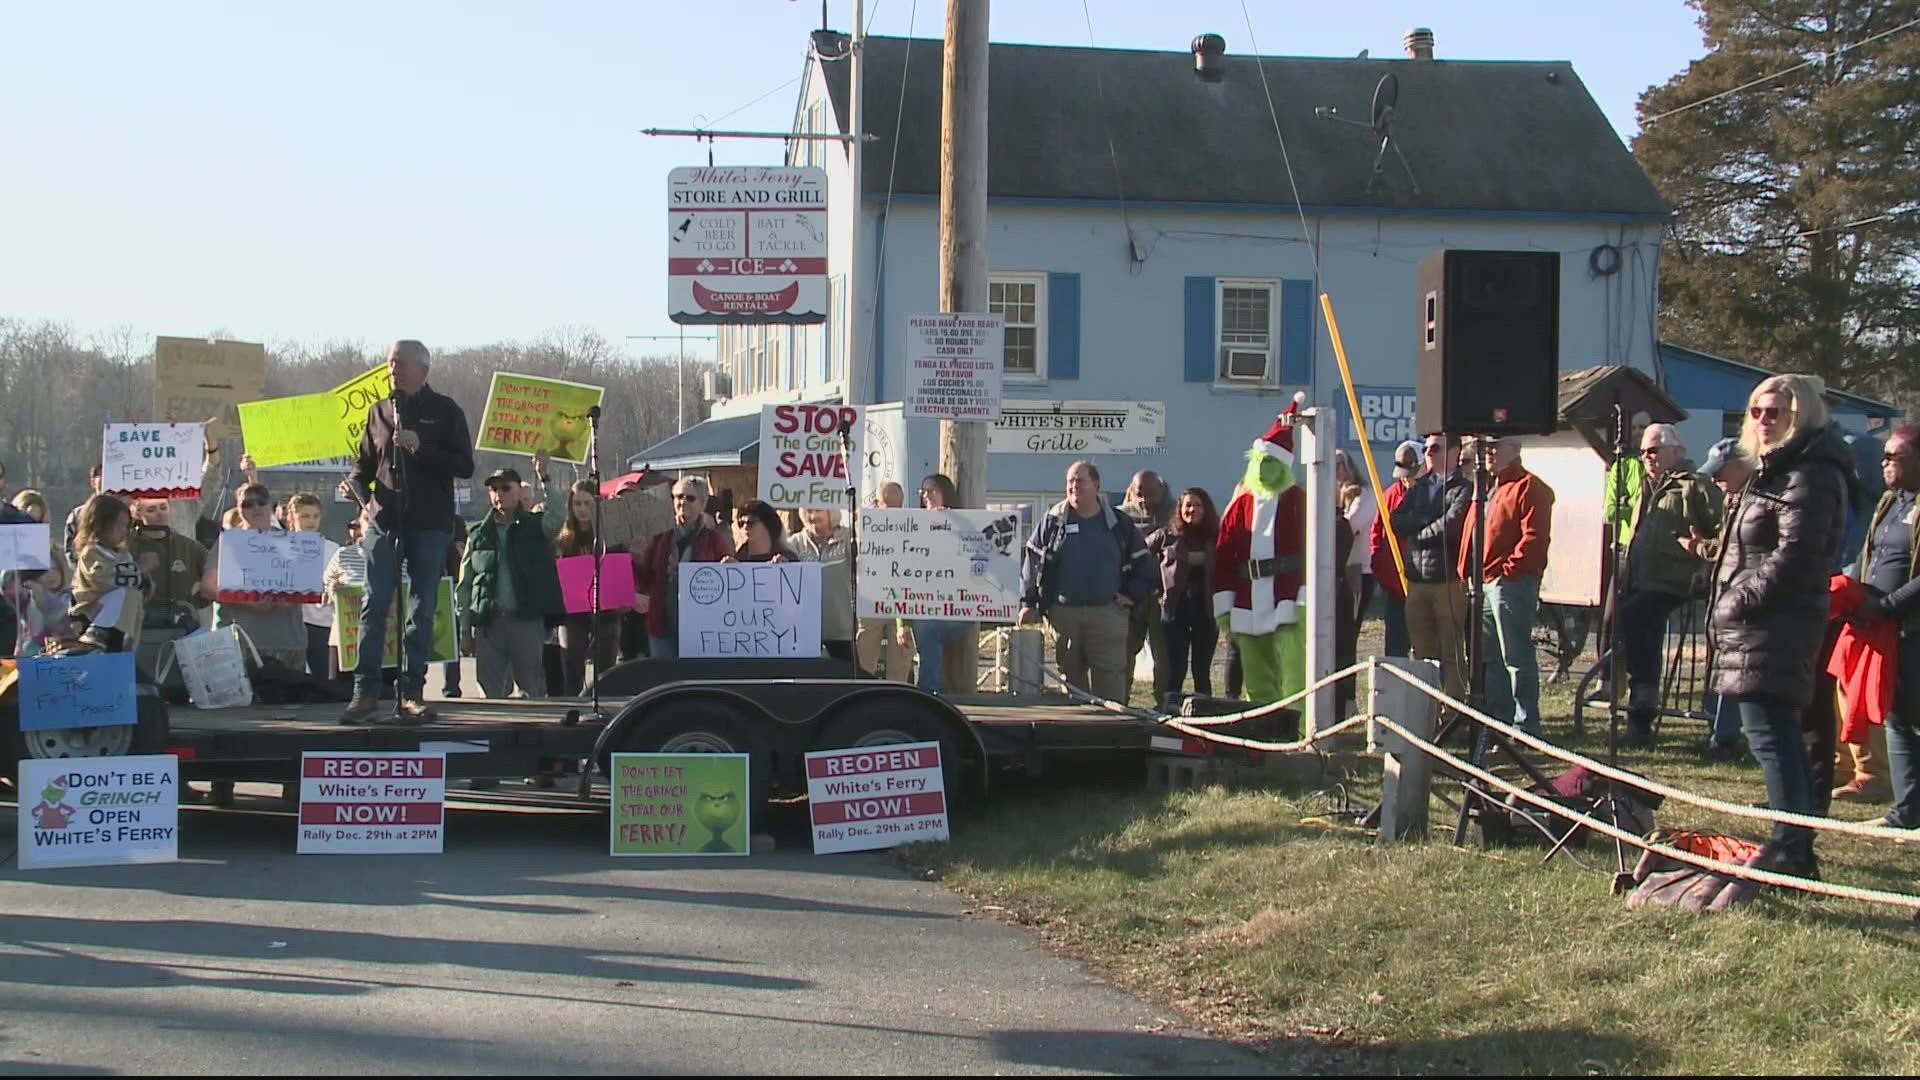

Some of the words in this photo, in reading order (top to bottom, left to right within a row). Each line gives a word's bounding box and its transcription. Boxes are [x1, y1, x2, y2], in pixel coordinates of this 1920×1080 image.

[673, 190, 726, 204] STORE
[731, 190, 770, 204] AND
[775, 190, 824, 204] GRILL
[699, 219, 736, 229] COLD
[758, 219, 785, 229] BAIT
[705, 230, 735, 240] BEER
[695, 241, 709, 251] TO
[716, 241, 736, 251] GO
[758, 241, 807, 251] TACKLE
[710, 293, 744, 301] CANOE
[754, 293, 780, 301] BOAT
[723, 301, 769, 310] RENTALS
[910, 319, 936, 327] PLEASE
[938, 320, 956, 328] HAVE
[977, 320, 999, 328] READY
[936, 347, 955, 355] CASH
[957, 347, 973, 355] ONLY
[939, 360, 947, 368] EL
[952, 370, 973, 378] FAVOR
[938, 379, 965, 387] COCHES
[927, 397, 945, 405] VIAJE
[948, 397, 956, 405] DE
[915, 406, 949, 414] EFECTIVO
[951, 406, 989, 415] SOLAMENTE
[522, 415, 542, 427] OUR
[774, 405, 857, 433] STOP
[994, 416, 1064, 428] WHITE'S
[1069, 416, 1126, 428] FERRY
[119, 430, 160, 442] SAVE
[487, 427, 541, 449] FERRY!
[773, 435, 800, 449] The
[806, 435, 856, 452] Grinh
[1027, 433, 1088, 452] Grille
[142, 446, 177, 458] OUR
[775, 451, 848, 478] SAVE
[769, 483, 805, 504] Our
[808, 481, 851, 504] Ferr
[862, 515, 920, 533] Poolesville
[247, 535, 279, 553] Save
[902, 540, 930, 557] Ferry
[866, 567, 877, 577] to
[891, 560, 955, 583] Reopen
[689, 565, 802, 605] OPEN
[901, 588, 934, 601] Town
[937, 590, 946, 601] is
[947, 593, 954, 602] a
[957, 589, 993, 603] Town,
[874, 601, 894, 615] No
[894, 601, 942, 617] Matter
[943, 602, 973, 617] How
[723, 608, 776, 629] OUR
[700, 625, 797, 655] FERRY!
[323, 759, 423, 777] REOPEN
[826, 751, 921, 775] REOPEN
[68, 771, 127, 788] DON'T
[132, 773, 155, 785] BE
[160, 772, 172, 785] A
[622, 766, 658, 779] DON'T
[319, 784, 379, 797] White's
[384, 785, 427, 800] Ferry
[621, 785, 642, 800] THE
[645, 785, 688, 799] GRINCH
[824, 780, 881, 796] White's
[886, 777, 926, 791] Ferry
[79, 791, 161, 806] GRINCH
[89, 809, 140, 824] OPEN
[335, 805, 408, 822] NOW!
[621, 804, 655, 817] STEAL
[660, 804, 684, 817] OUR
[844, 798, 911, 820] NOW!
[34, 828, 112, 847] WHITE'S
[118, 827, 174, 842] FERRY
[303, 830, 332, 841] Rally
[336, 830, 362, 840] Dec.
[366, 830, 392, 840] 29th
[396, 830, 408, 840] at
[411, 830, 437, 840] 2PM
[619, 822, 687, 846] FERRY!
[818, 829, 844, 841] Rally
[848, 827, 872, 837] Dec.
[875, 822, 900, 834] 29th
[904, 821, 915, 831] at
[918, 818, 942, 831] 2PM
